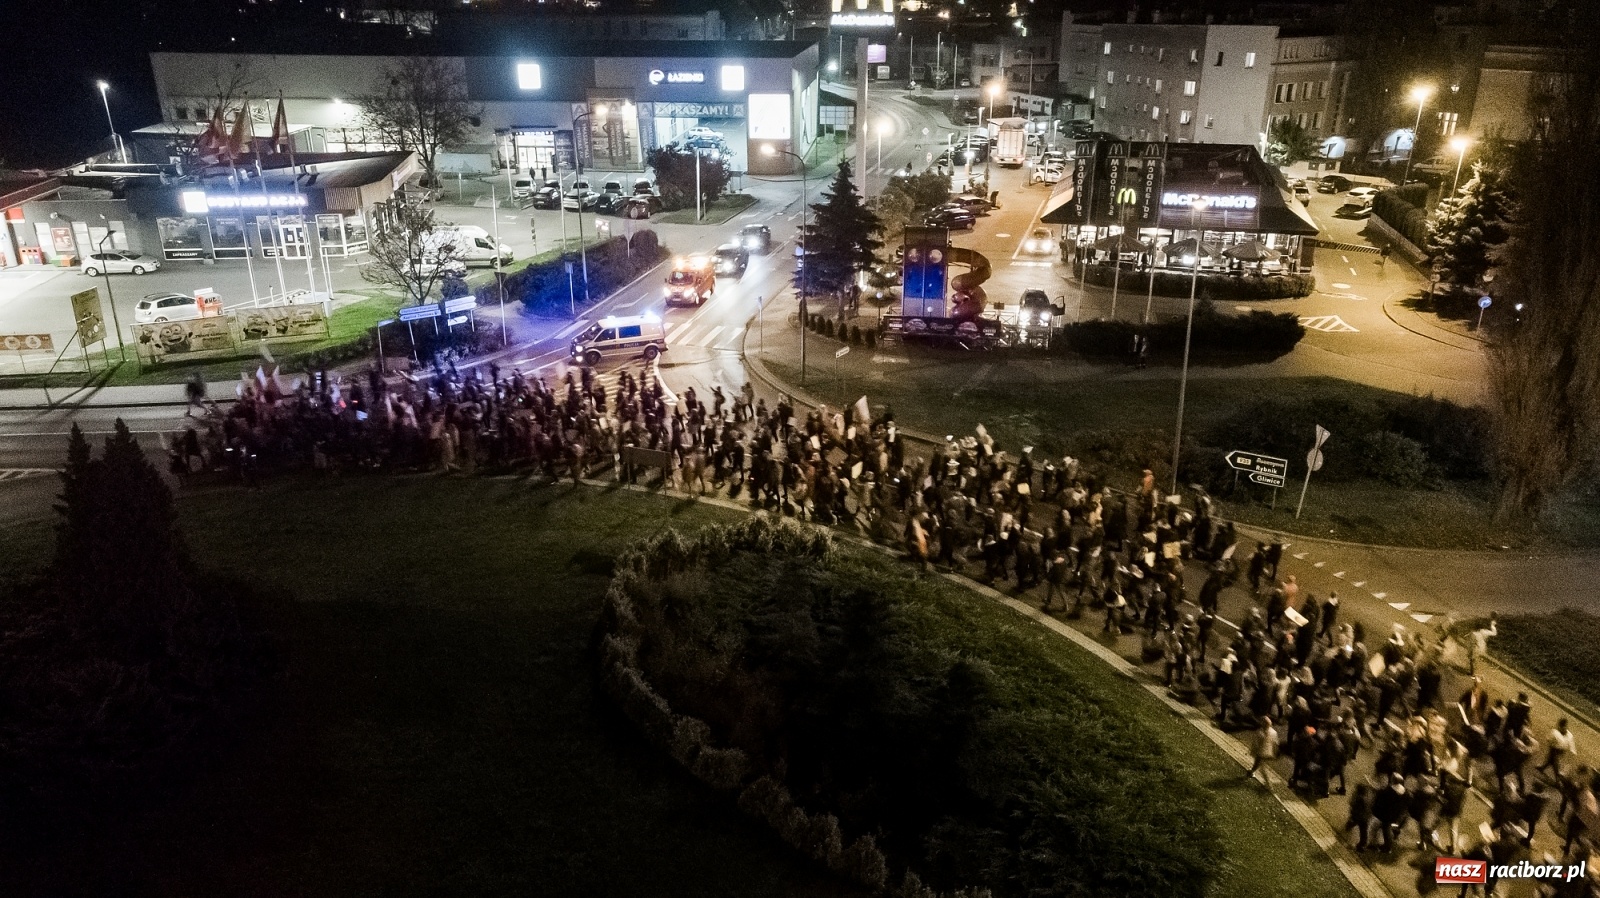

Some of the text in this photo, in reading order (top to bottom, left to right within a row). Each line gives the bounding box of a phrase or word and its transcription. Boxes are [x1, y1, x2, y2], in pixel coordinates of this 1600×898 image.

[656, 105, 729, 116] ZAPRASZAMY!
[1162, 192, 1257, 209] McDonald's
[1255, 465, 1278, 474] Rybnik
[1256, 475, 1281, 485] Gliwice
